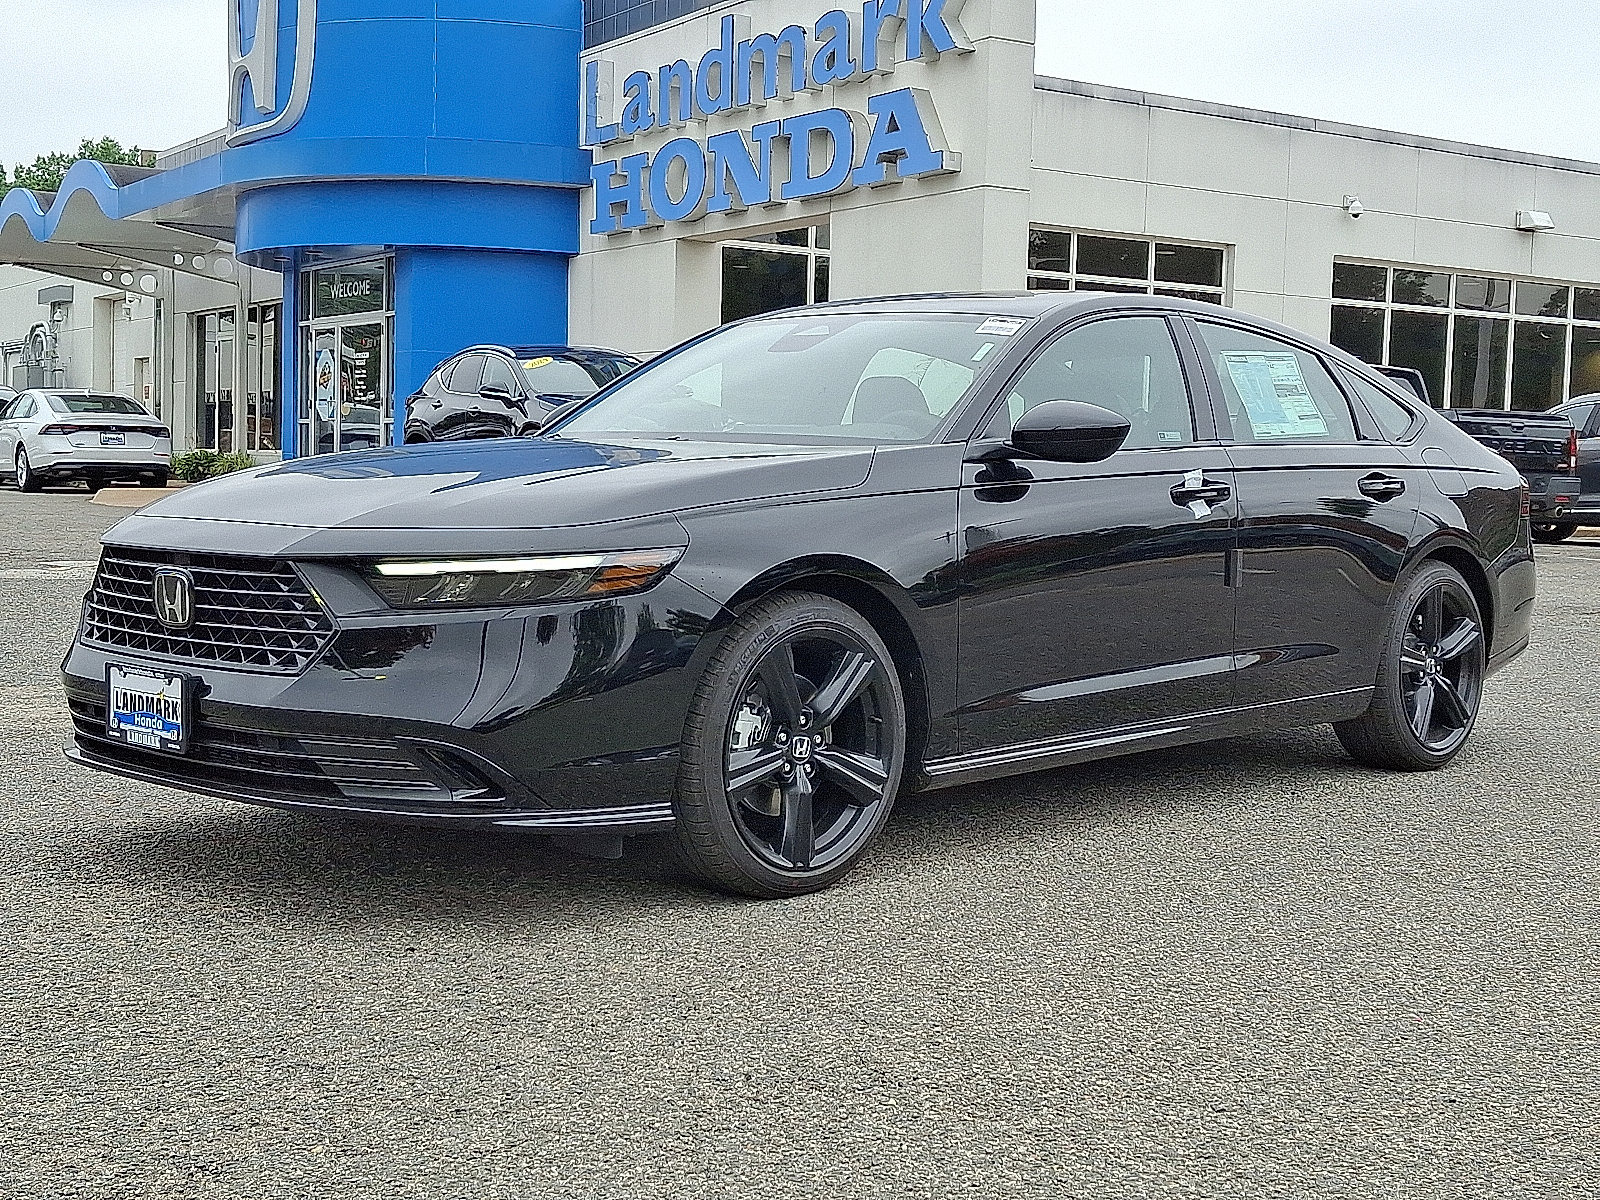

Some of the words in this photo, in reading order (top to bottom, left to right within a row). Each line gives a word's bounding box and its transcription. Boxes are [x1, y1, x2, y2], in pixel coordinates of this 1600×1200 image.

[585, 0, 957, 146] Landmark
[590, 88, 943, 234] HONDA
[330, 279, 371, 299] WELCOME
[114, 689, 179, 722] LANDMARK
[134, 713, 163, 730] Honda
